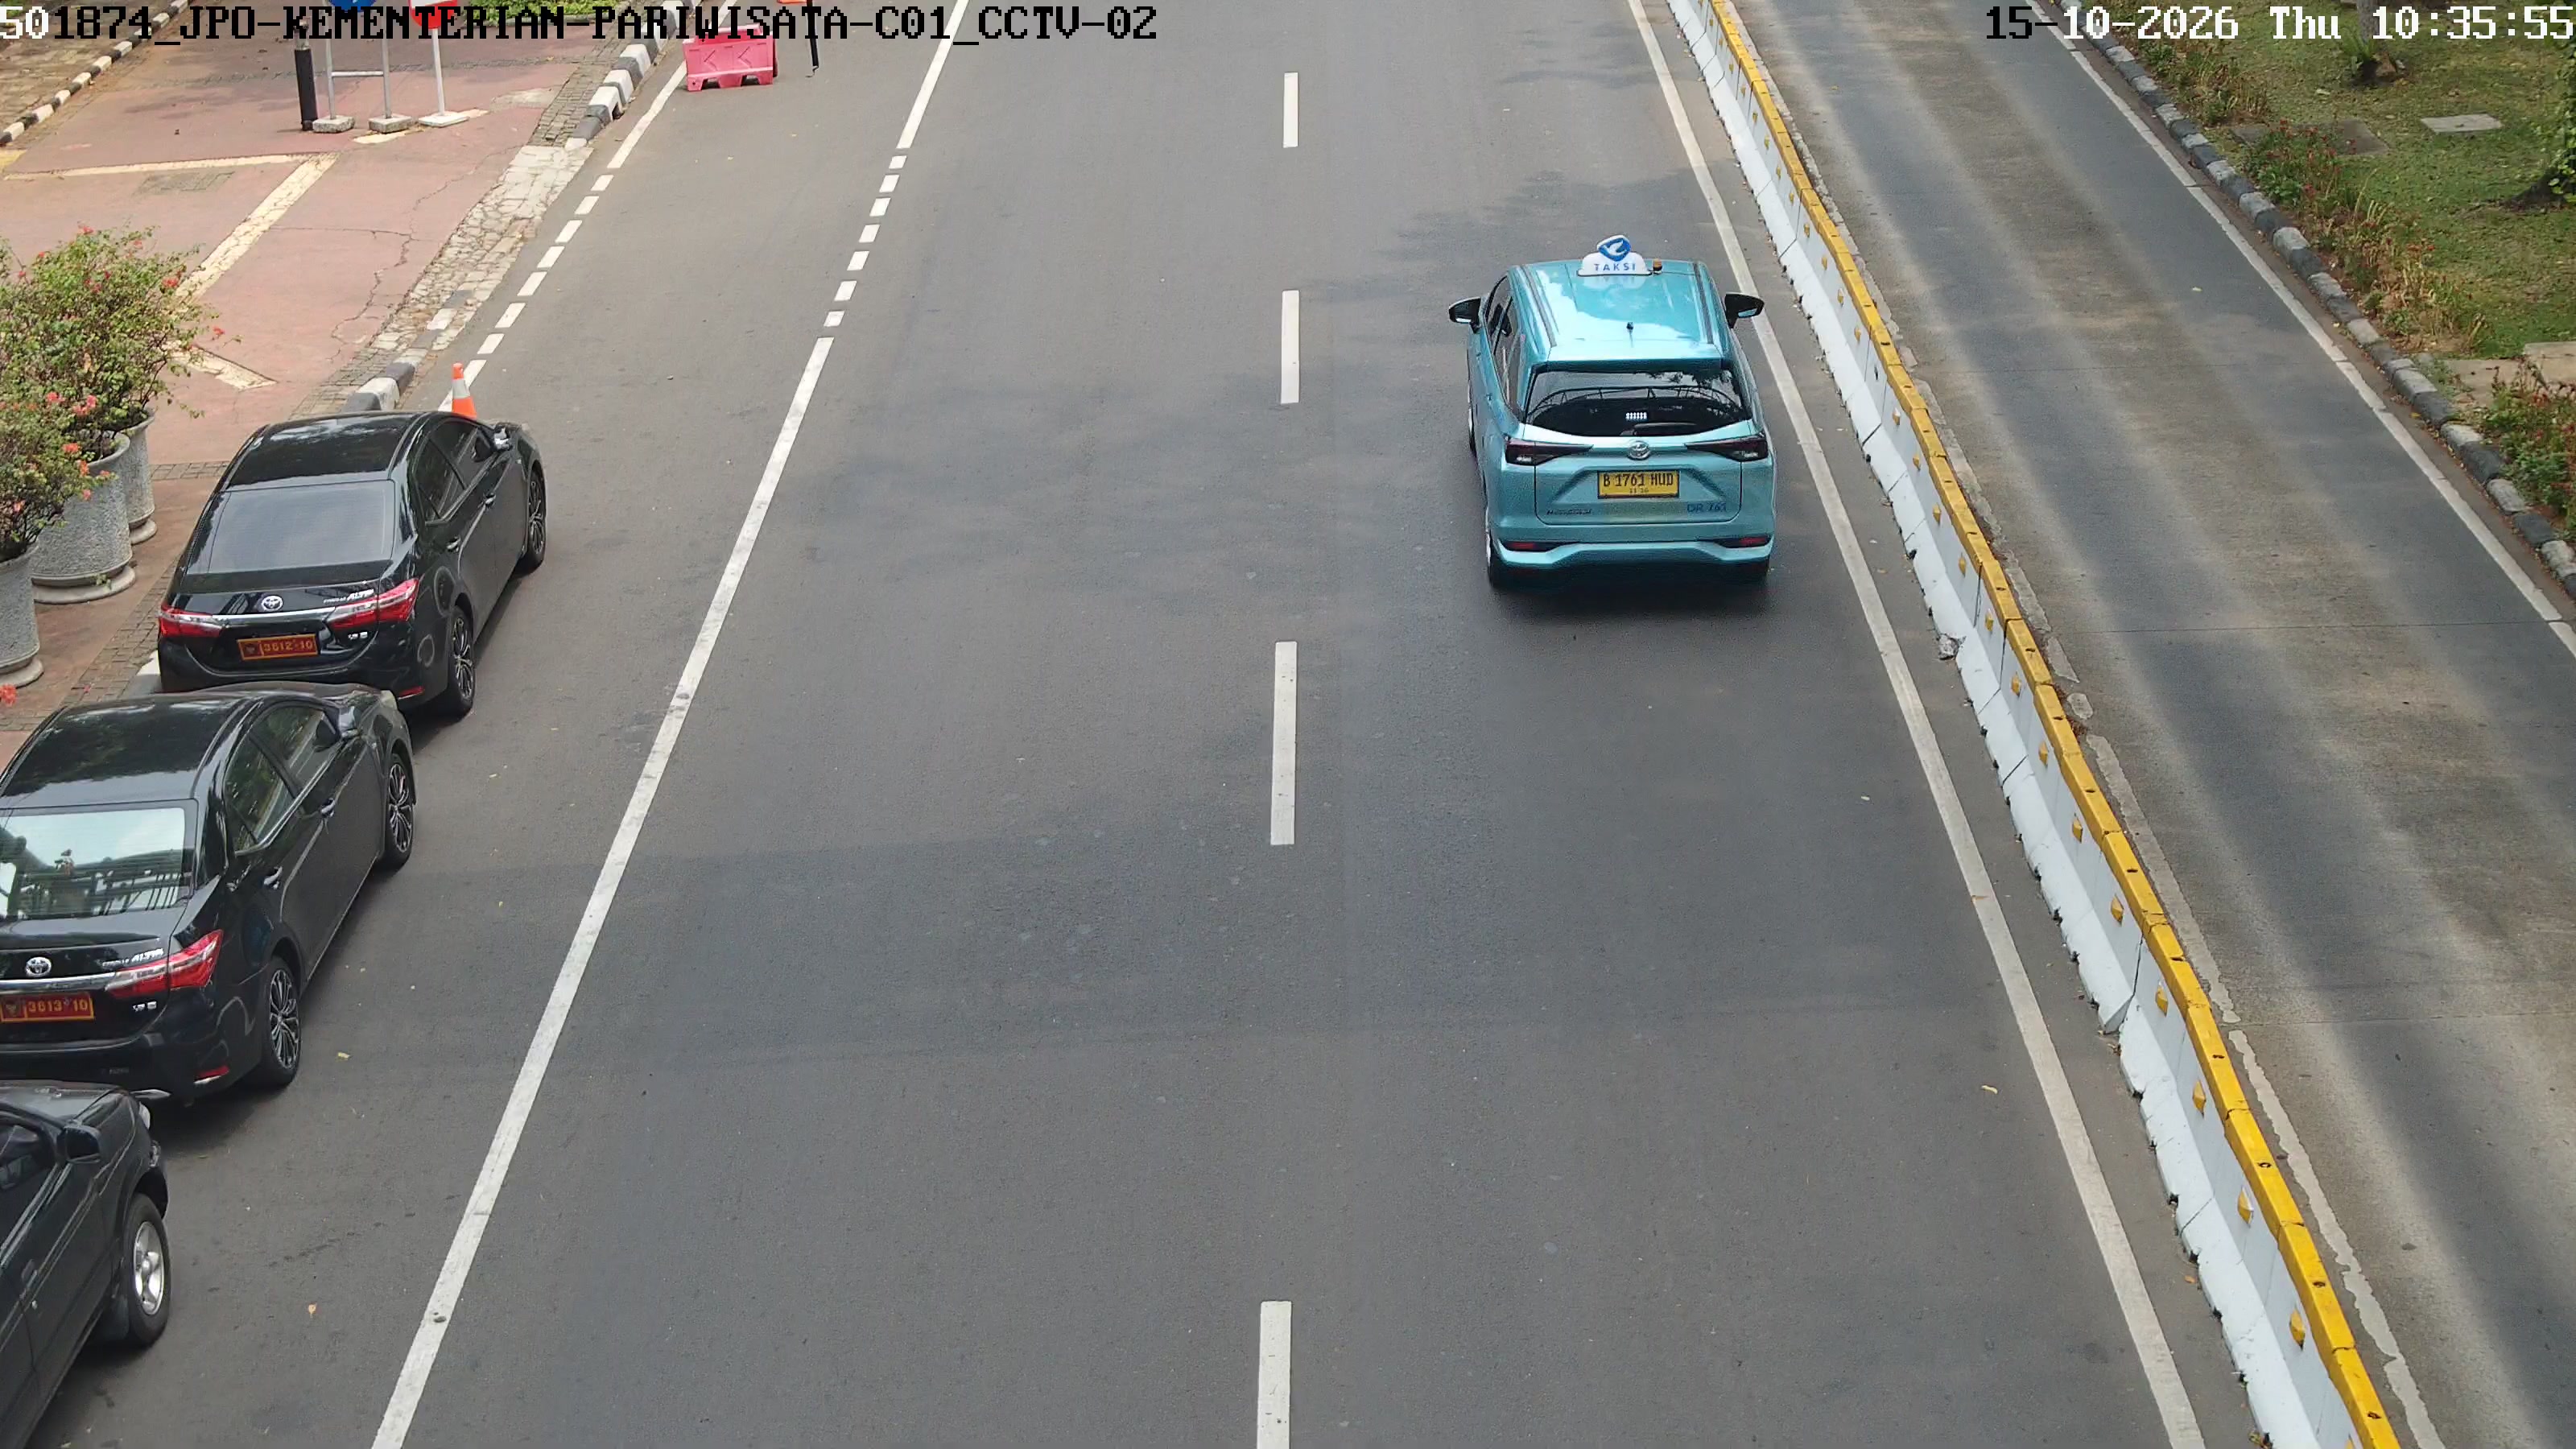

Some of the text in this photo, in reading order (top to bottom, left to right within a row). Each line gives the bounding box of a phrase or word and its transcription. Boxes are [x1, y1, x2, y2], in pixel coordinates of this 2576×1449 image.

[1594, 262, 1636, 271] TAKSI
[1604, 473, 1611, 487] B
[1651, 473, 1674, 486] HUD
